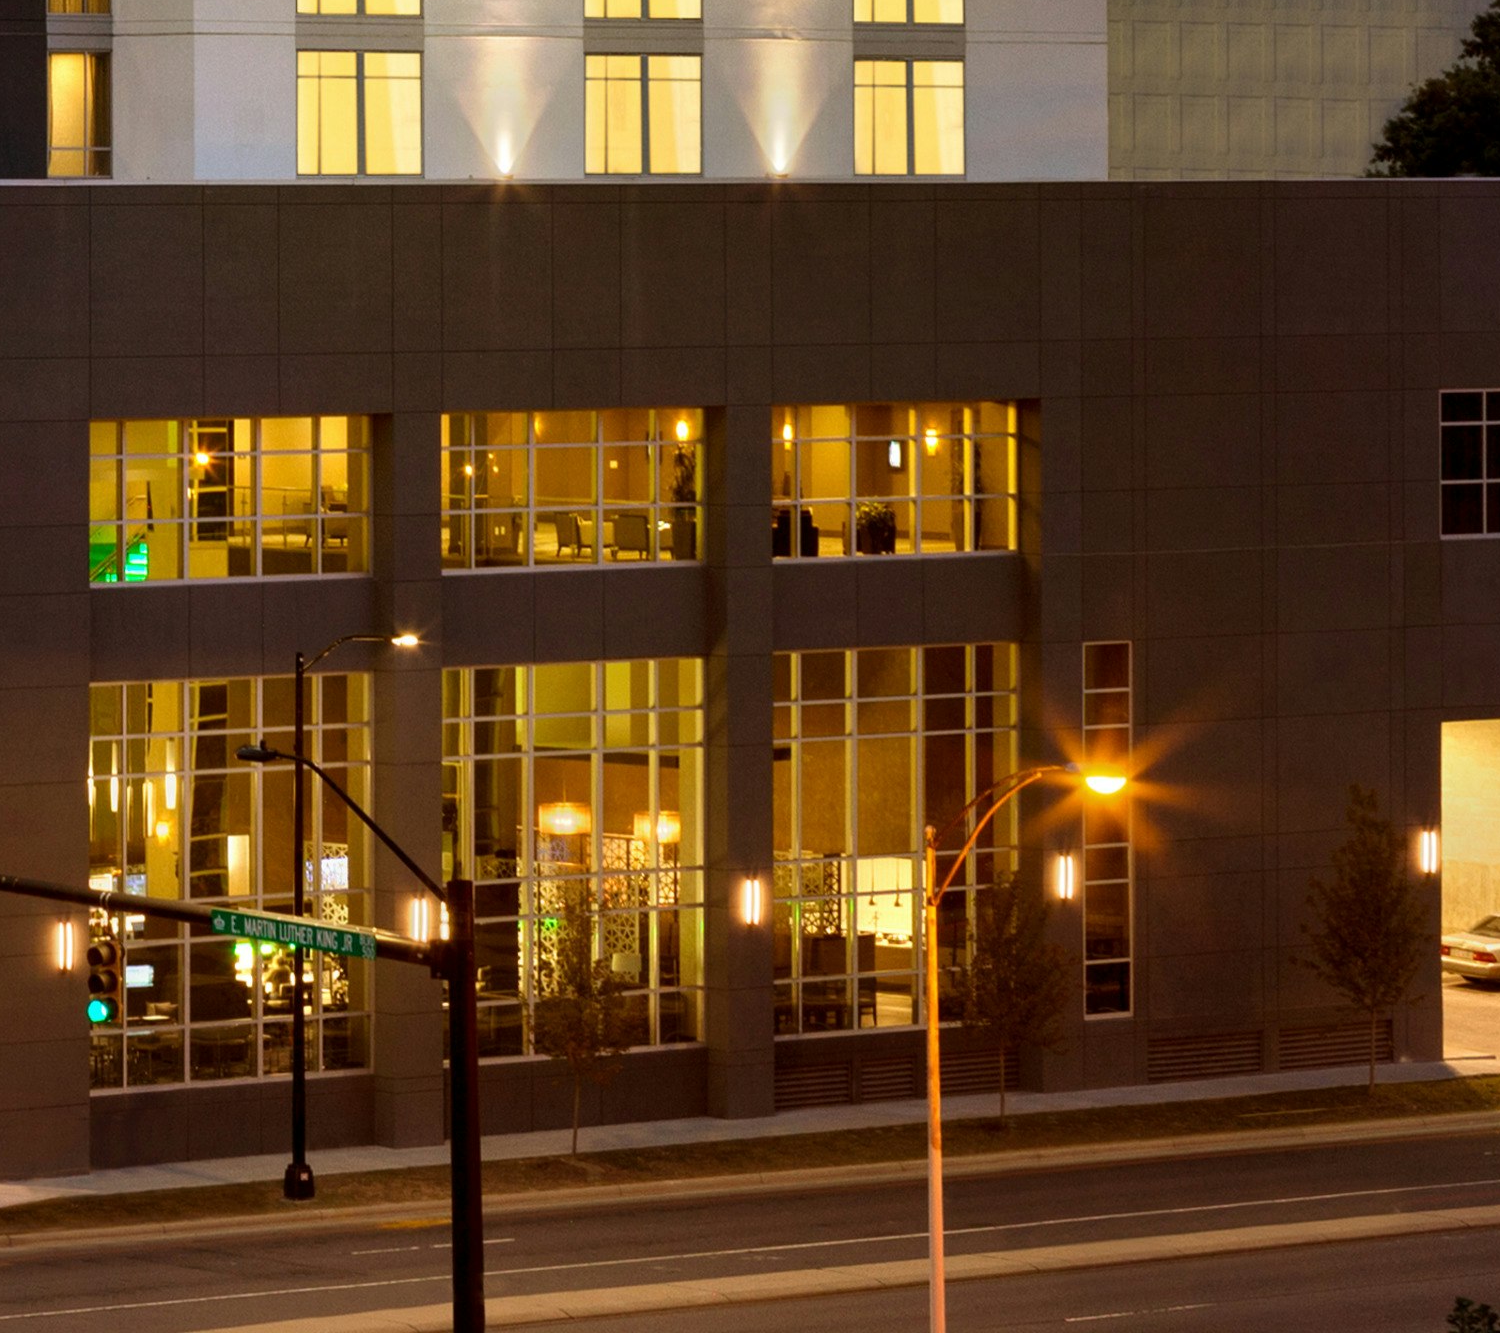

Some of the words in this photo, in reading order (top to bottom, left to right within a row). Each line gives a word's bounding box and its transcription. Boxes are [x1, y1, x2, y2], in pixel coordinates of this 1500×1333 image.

[230, 915, 241, 934] E.
[244, 917, 277, 941] MARTIN
[279, 921, 313, 946] LUTHER
[316, 929, 338, 950] KING
[341, 934, 353, 952] JR
